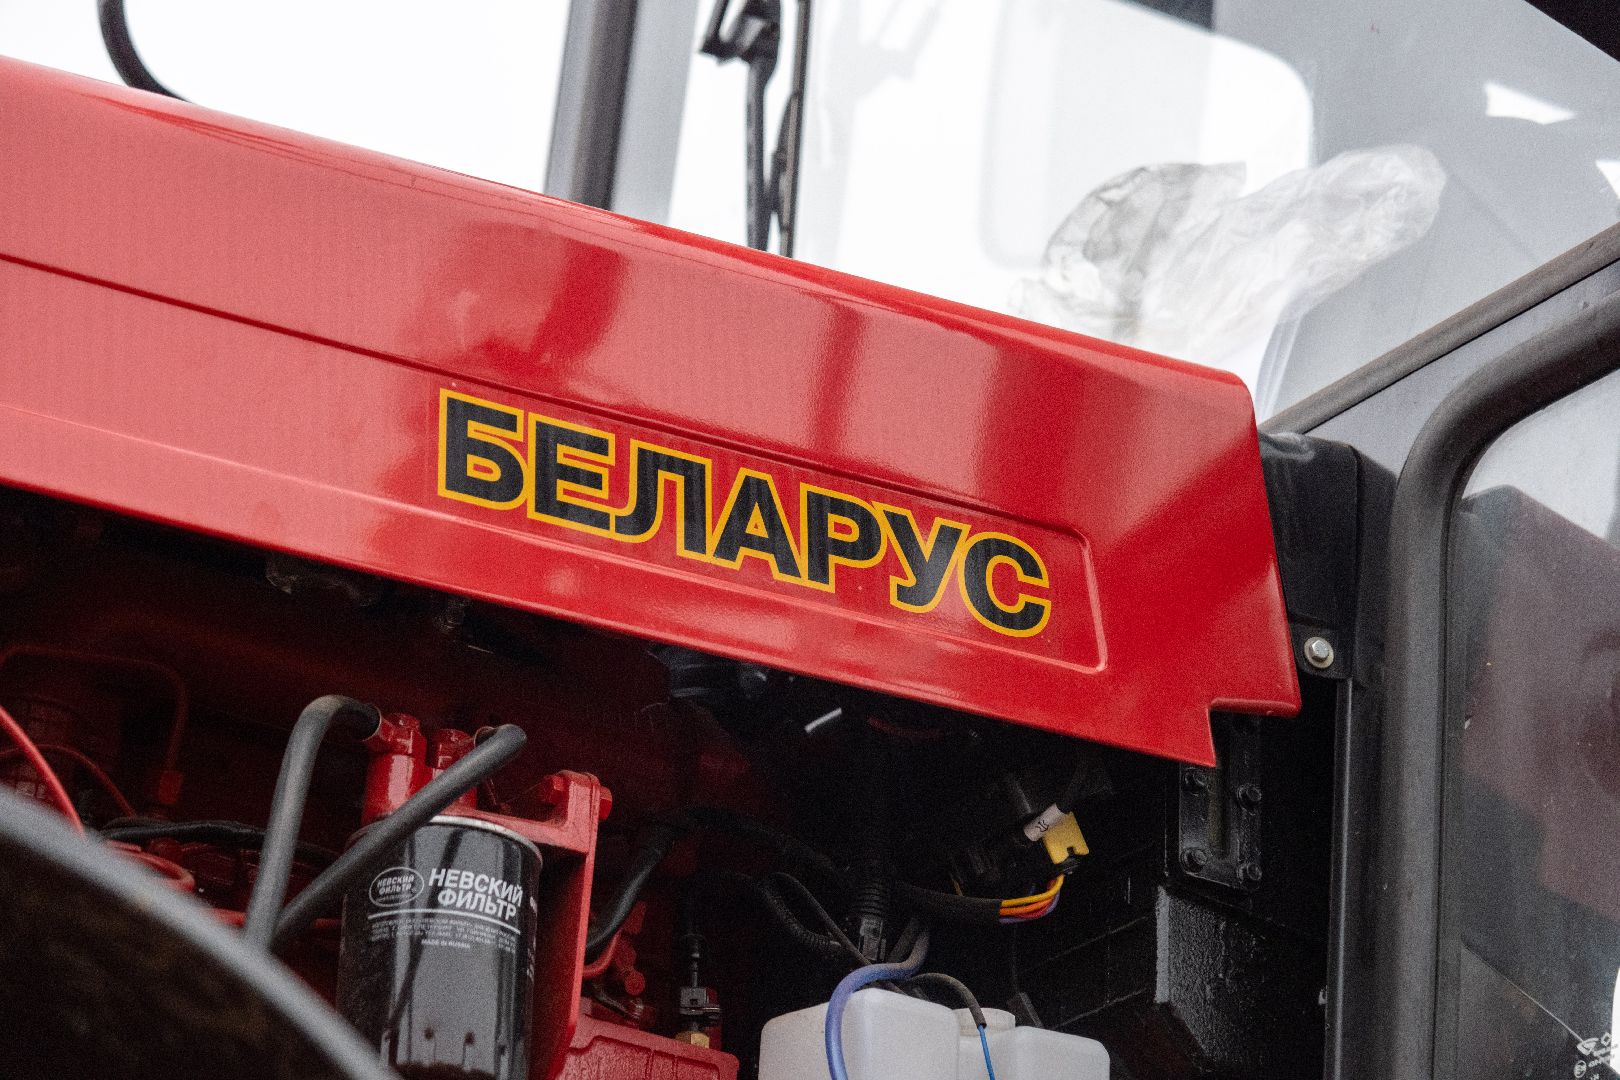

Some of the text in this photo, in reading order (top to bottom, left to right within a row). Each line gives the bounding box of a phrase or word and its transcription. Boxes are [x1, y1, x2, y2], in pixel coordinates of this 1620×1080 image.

[437, 387, 1052, 637] БЕЛАРУС
[428, 868, 524, 907] НЕВСКИЙ
[438, 888, 517, 920] ФИЛЬТР
